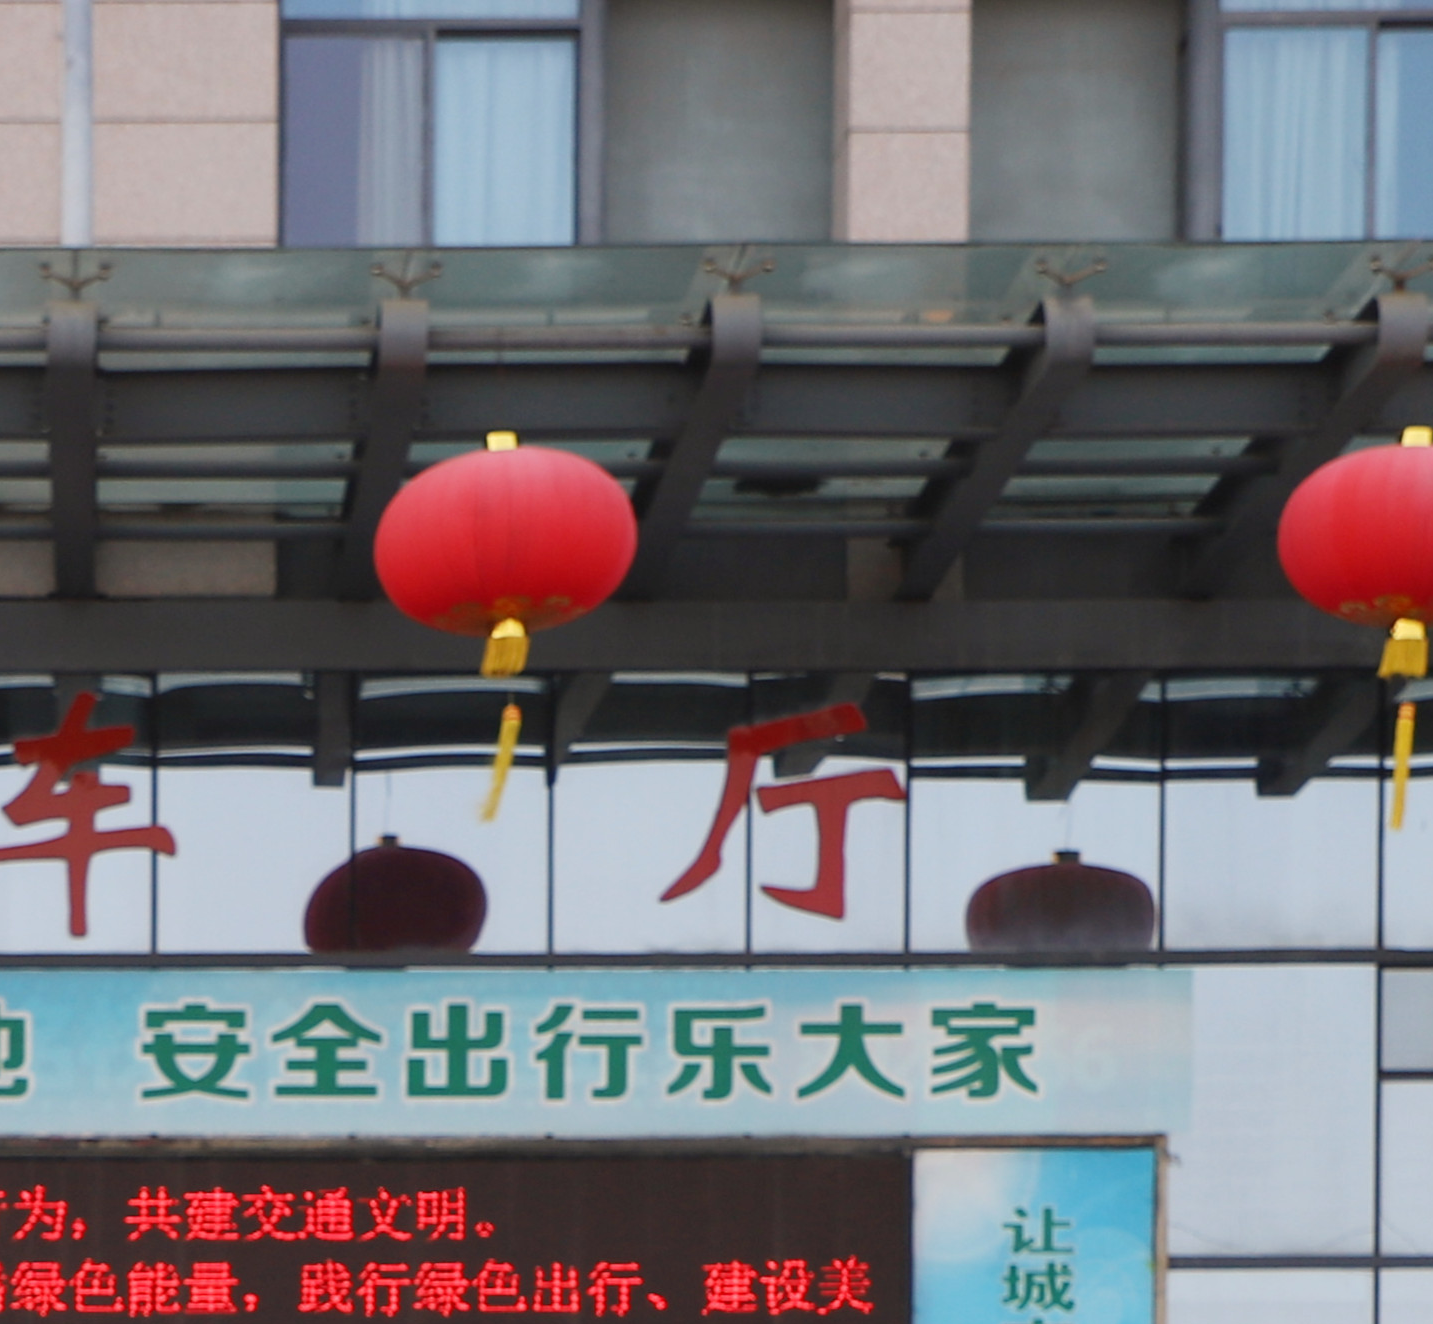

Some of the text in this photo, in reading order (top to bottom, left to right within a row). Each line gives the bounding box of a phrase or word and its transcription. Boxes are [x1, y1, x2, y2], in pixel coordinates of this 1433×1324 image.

[140, 1002, 1041, 1101] 安全出行乐大家
